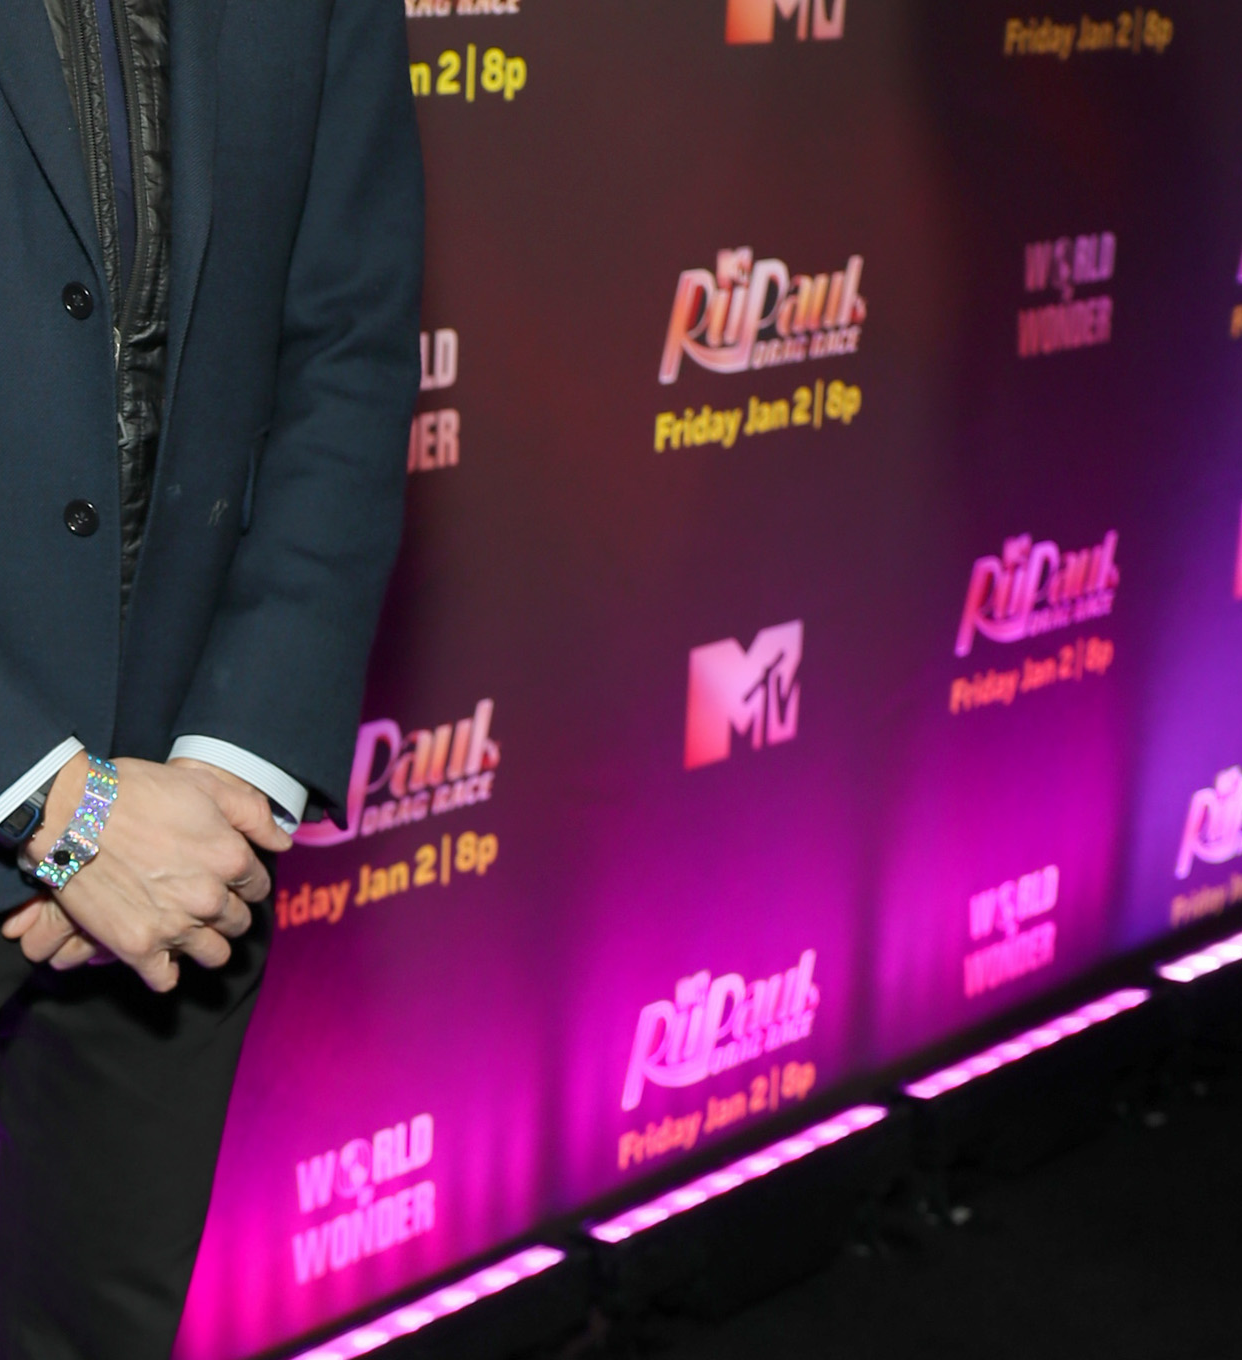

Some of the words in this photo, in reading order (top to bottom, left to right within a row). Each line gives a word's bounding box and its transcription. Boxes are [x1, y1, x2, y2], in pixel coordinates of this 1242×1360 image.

[436, 49, 462, 96] 2
[480, 46, 528, 102] 8p
[653, 404, 743, 454] Friday
[743, 395, 790, 437] Jan
[791, 385, 813, 427] 2
[825, 379, 862, 426] 8p
[684, 619, 804, 772] MTV
[275, 879, 351, 930] iday
[355, 861, 411, 906] Jan
[413, 844, 438, 888] 2
[455, 830, 499, 877] 8p
[292, 1180, 436, 1285] WONDER
